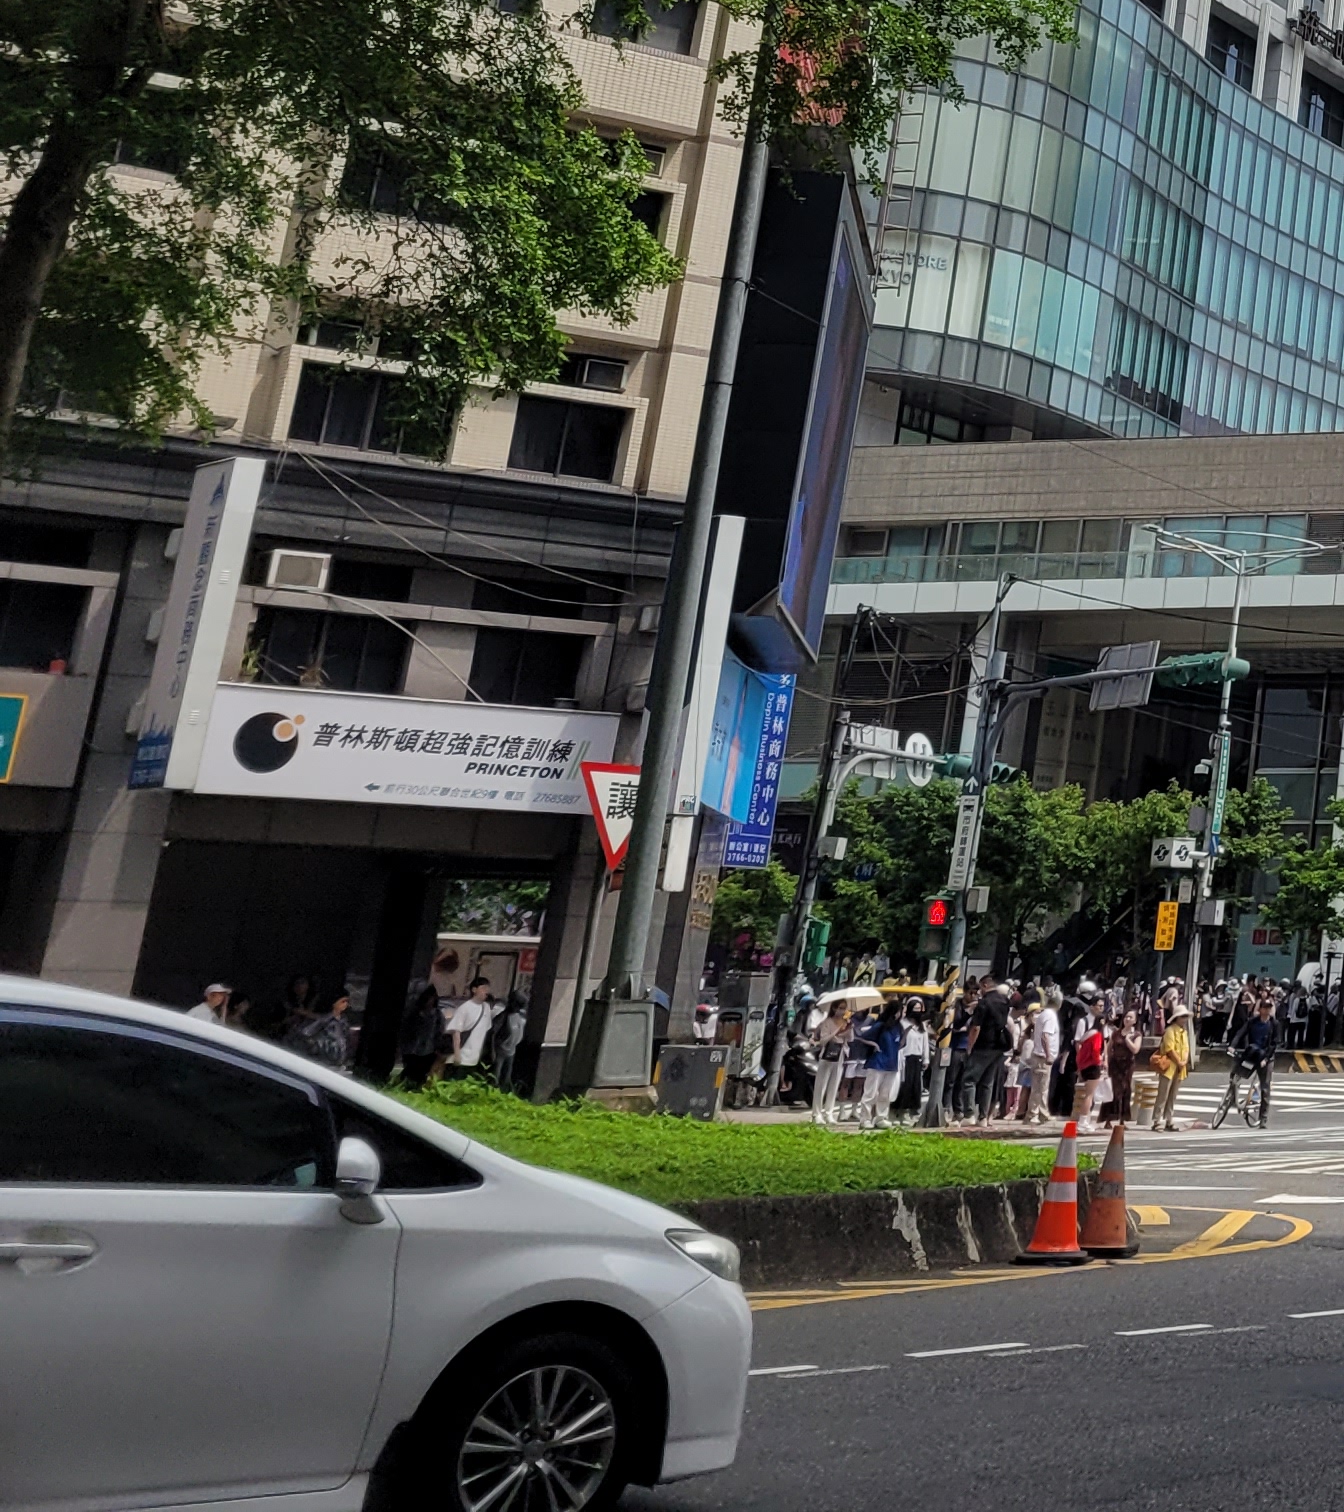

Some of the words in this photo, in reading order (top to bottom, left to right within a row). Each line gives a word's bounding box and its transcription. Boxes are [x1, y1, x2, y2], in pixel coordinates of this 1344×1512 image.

[312, 722, 577, 763] 普林斯頓超強記憶訓練
[464, 762, 564, 780] PRINCETON
[606, 781, 639, 820] 讓
